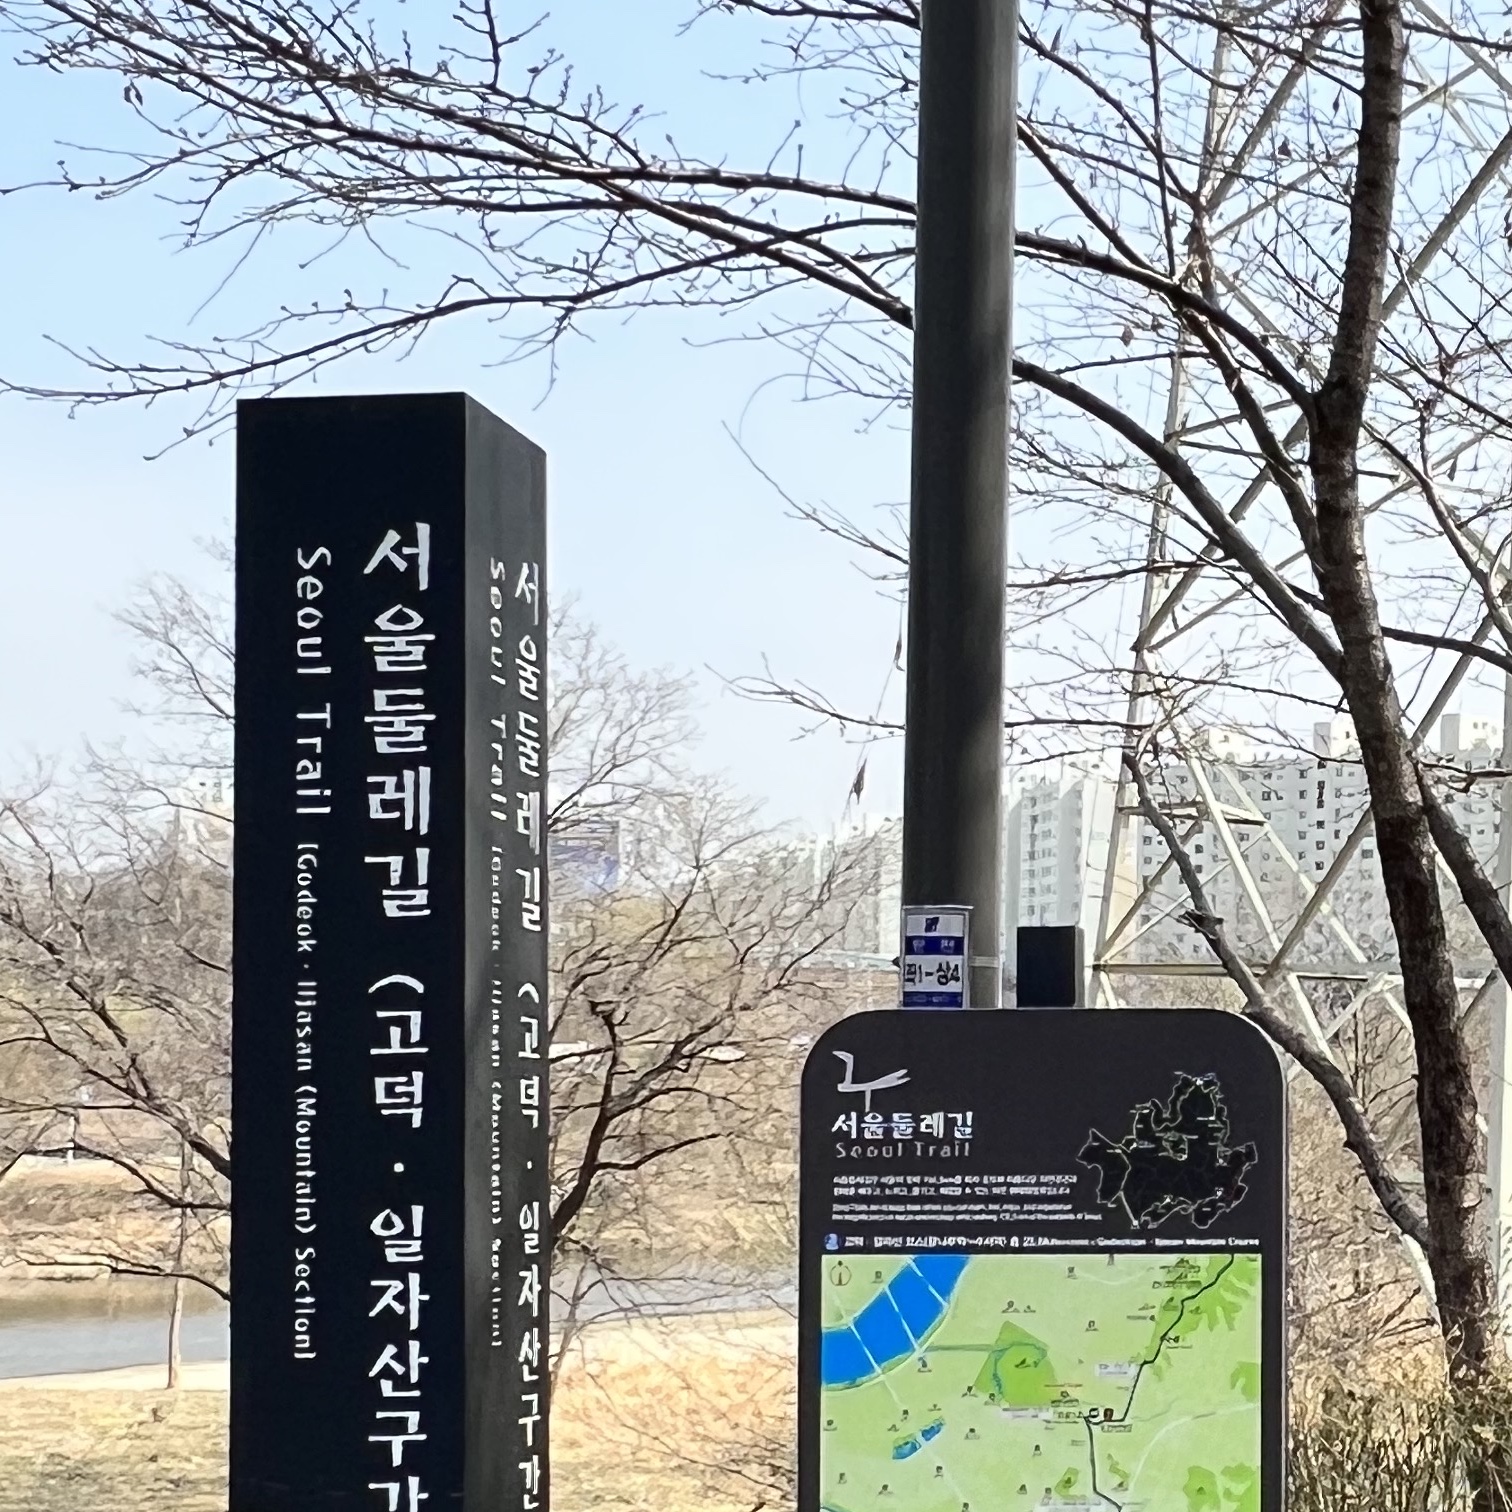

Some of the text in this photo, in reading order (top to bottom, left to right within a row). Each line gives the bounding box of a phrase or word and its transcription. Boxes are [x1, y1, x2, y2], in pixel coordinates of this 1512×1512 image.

[295, 545, 332, 675] Seoul
[295, 702, 332, 815] Trail
[364, 521, 435, 919] 서울둘레길
[513, 561, 542, 933] 서울둘레길
[293, 1084, 318, 1235] (Mountain)
[831, 1111, 975, 1141] 서울둘레길
[915, 1140, 972, 1159] Trail
[293, 1247, 318, 1360] Section]
